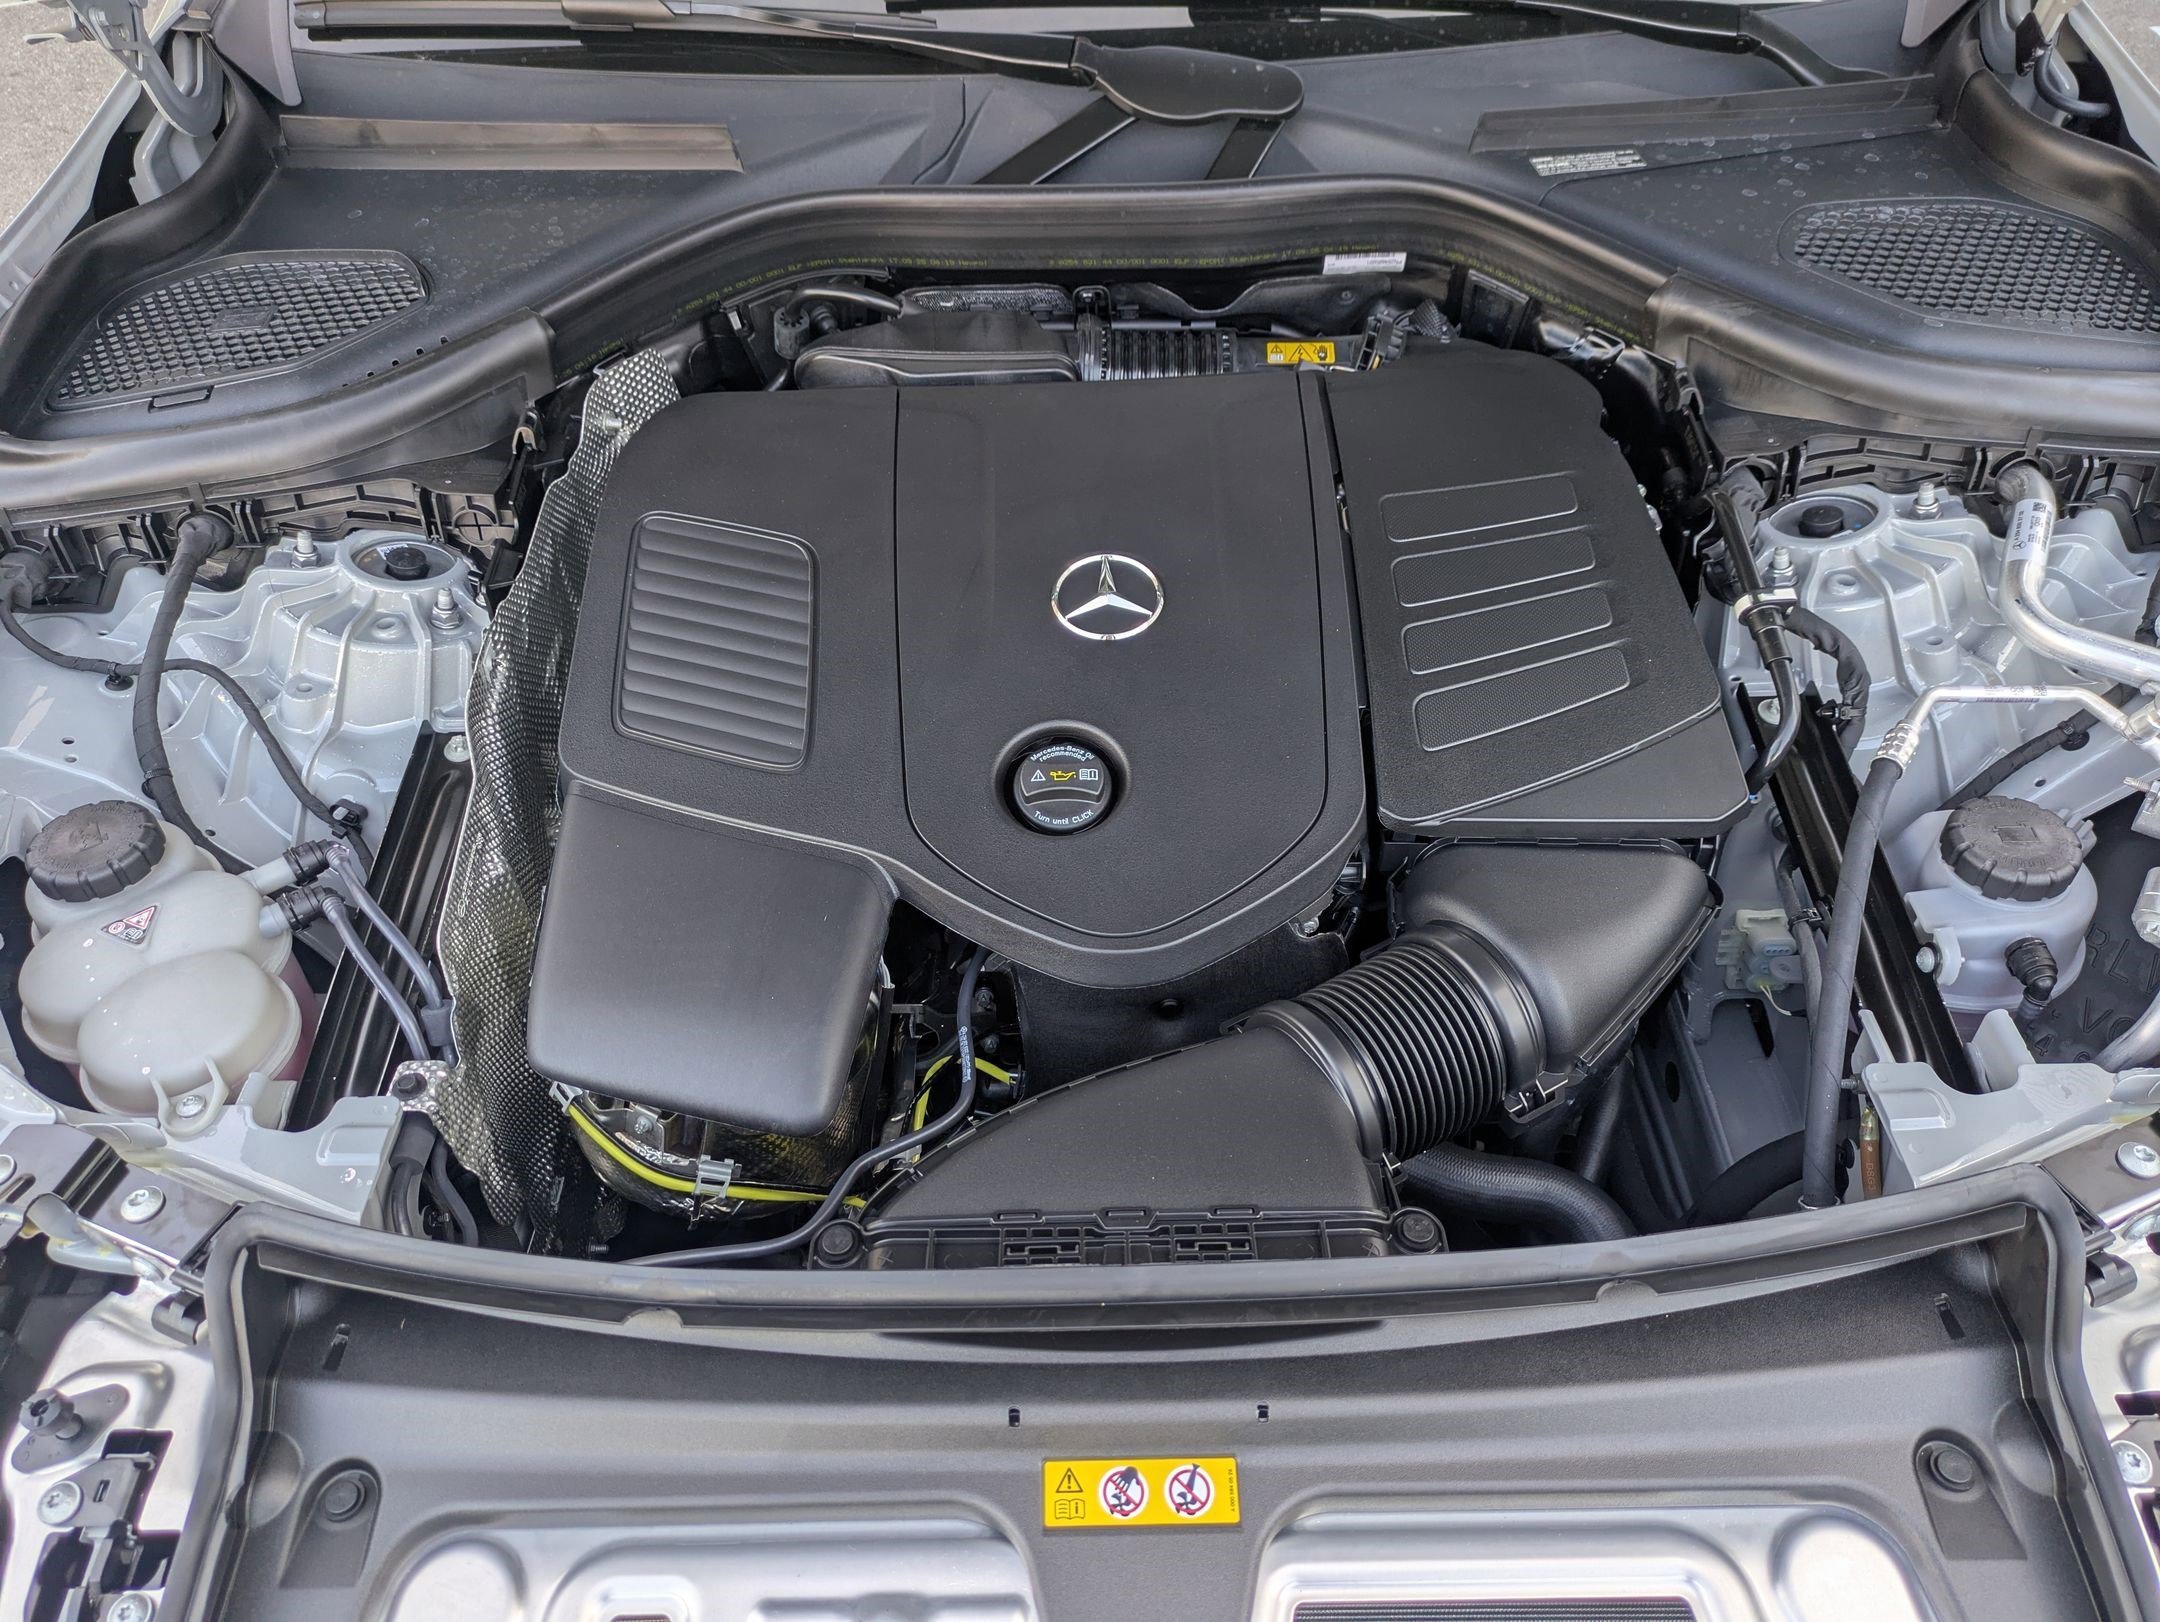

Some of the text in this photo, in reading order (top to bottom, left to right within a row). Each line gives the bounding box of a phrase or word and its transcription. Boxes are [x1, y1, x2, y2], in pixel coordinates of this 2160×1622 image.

[1030, 745, 1095, 761] Mercedes-Benz Oil
[1039, 750, 1087, 762] recommended
[1034, 809, 1094, 825] Turn until CLICK
